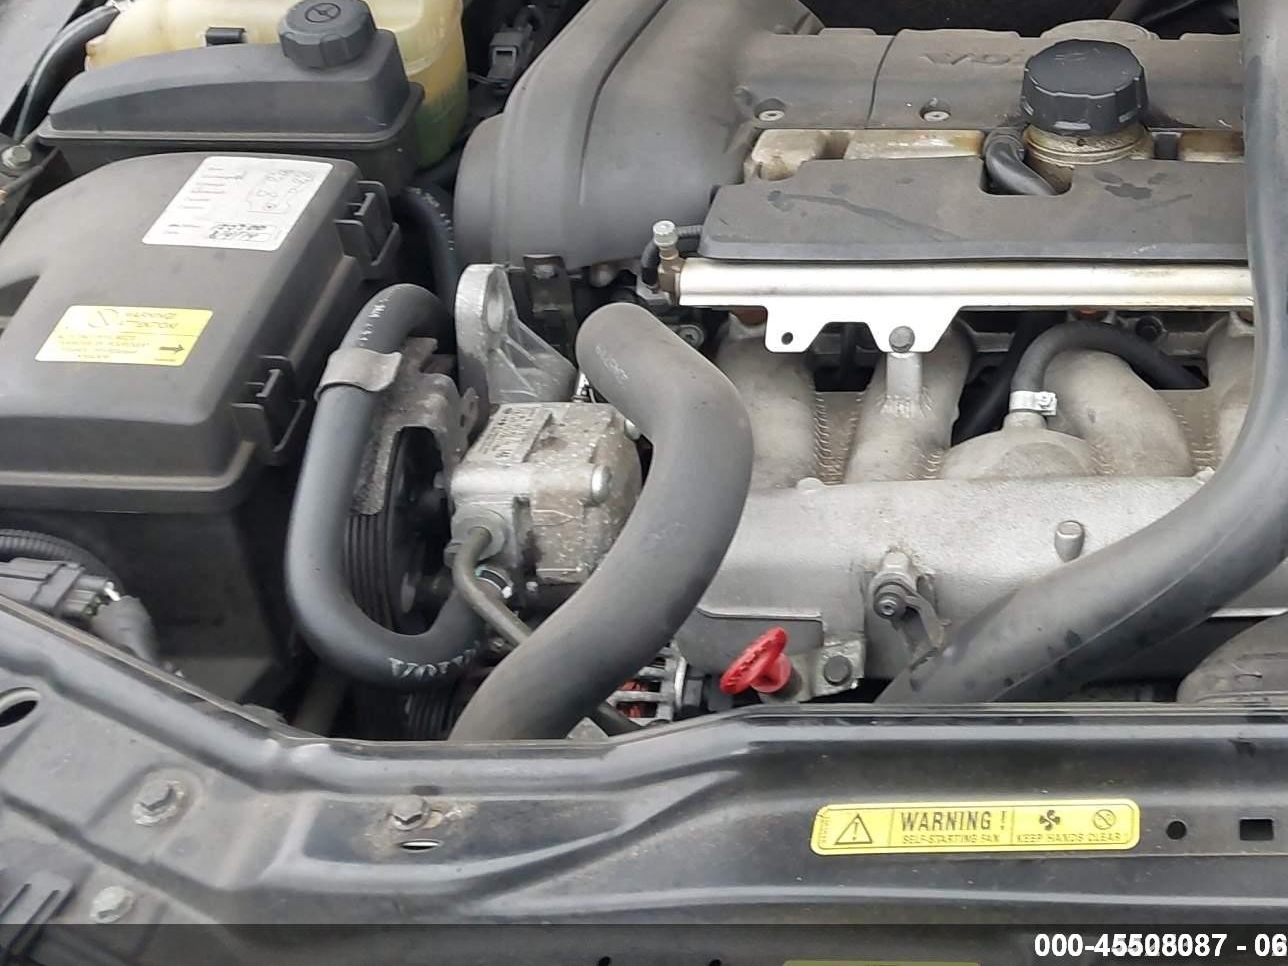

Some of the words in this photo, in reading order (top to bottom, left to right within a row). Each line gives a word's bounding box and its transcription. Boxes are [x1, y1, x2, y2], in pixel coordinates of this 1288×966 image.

[900, 810, 992, 832] WARNING
[902, 833, 977, 845] SELF-STARTING
[979, 833, 1001, 844] FAN
[1016, 833, 1045, 843] KEEP
[1047, 832, 1084, 843] HANDS
[1087, 831, 1121, 842] CLEAR
